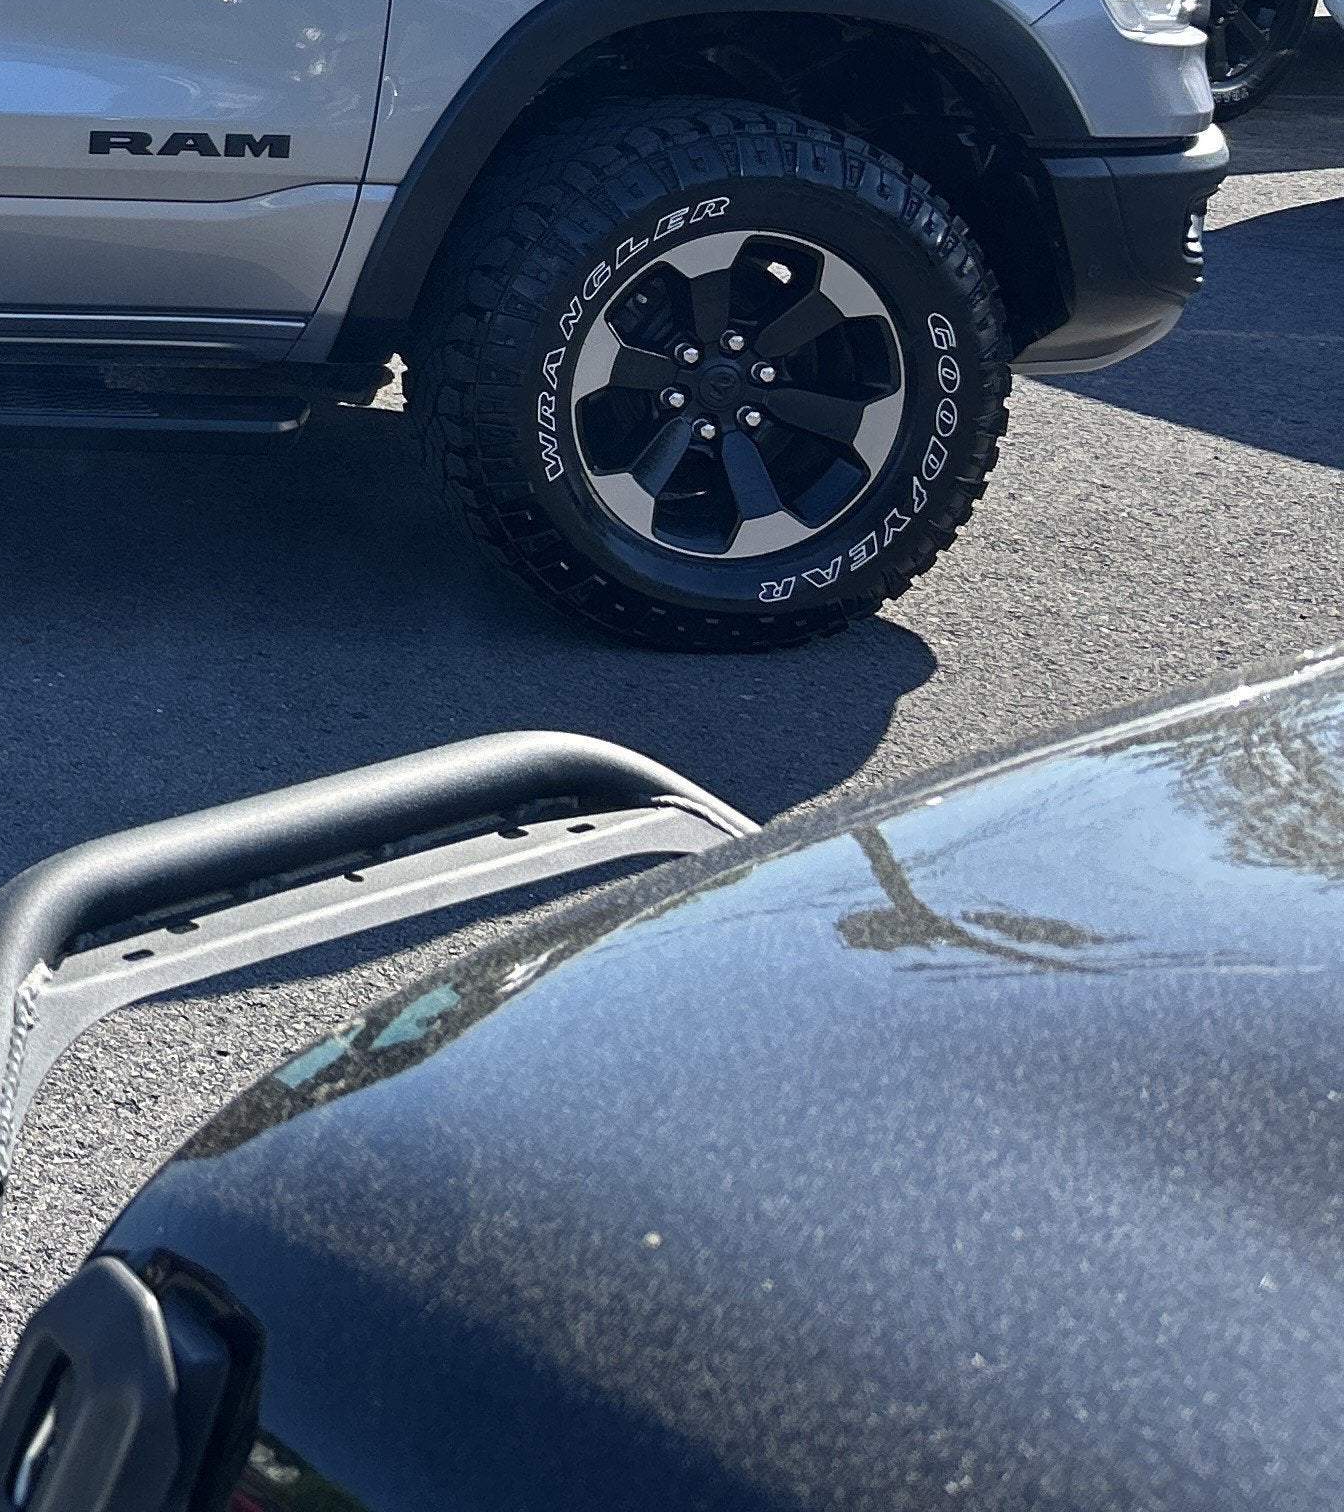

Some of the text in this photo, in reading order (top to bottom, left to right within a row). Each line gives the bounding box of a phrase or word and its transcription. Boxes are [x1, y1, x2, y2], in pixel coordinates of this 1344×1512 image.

[89, 131, 291, 158] RAM
[532, 196, 730, 483] WRANGLER
[759, 312, 960, 603] GOODYEAR
